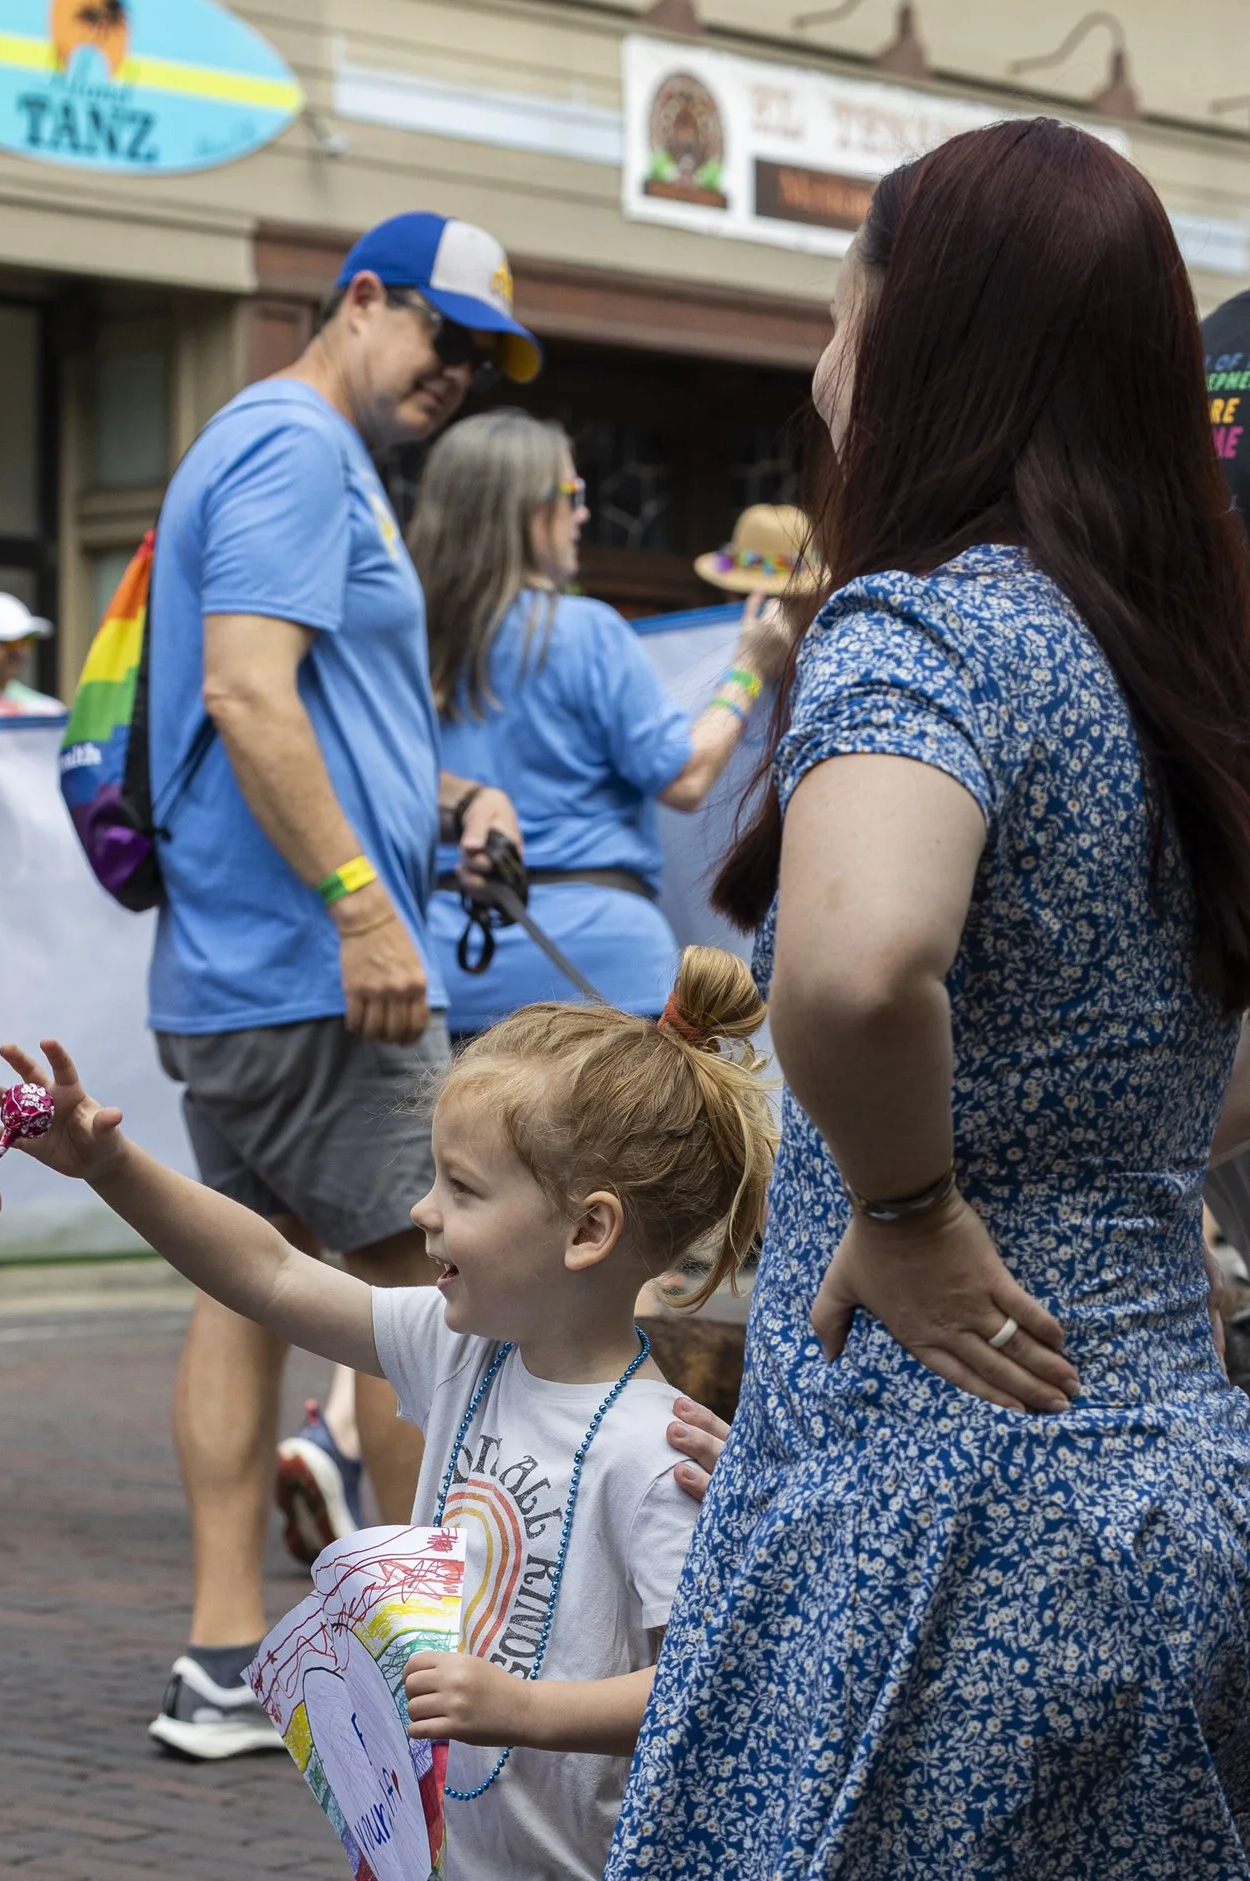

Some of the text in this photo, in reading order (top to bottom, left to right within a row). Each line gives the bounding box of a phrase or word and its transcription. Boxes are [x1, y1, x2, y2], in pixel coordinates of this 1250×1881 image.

[16, 92, 159, 163] TANZ
[1210, 397, 1241, 424] RE
[20, 1100, 47, 1113] Toots
[498, 1455, 563, 1540] ALL
